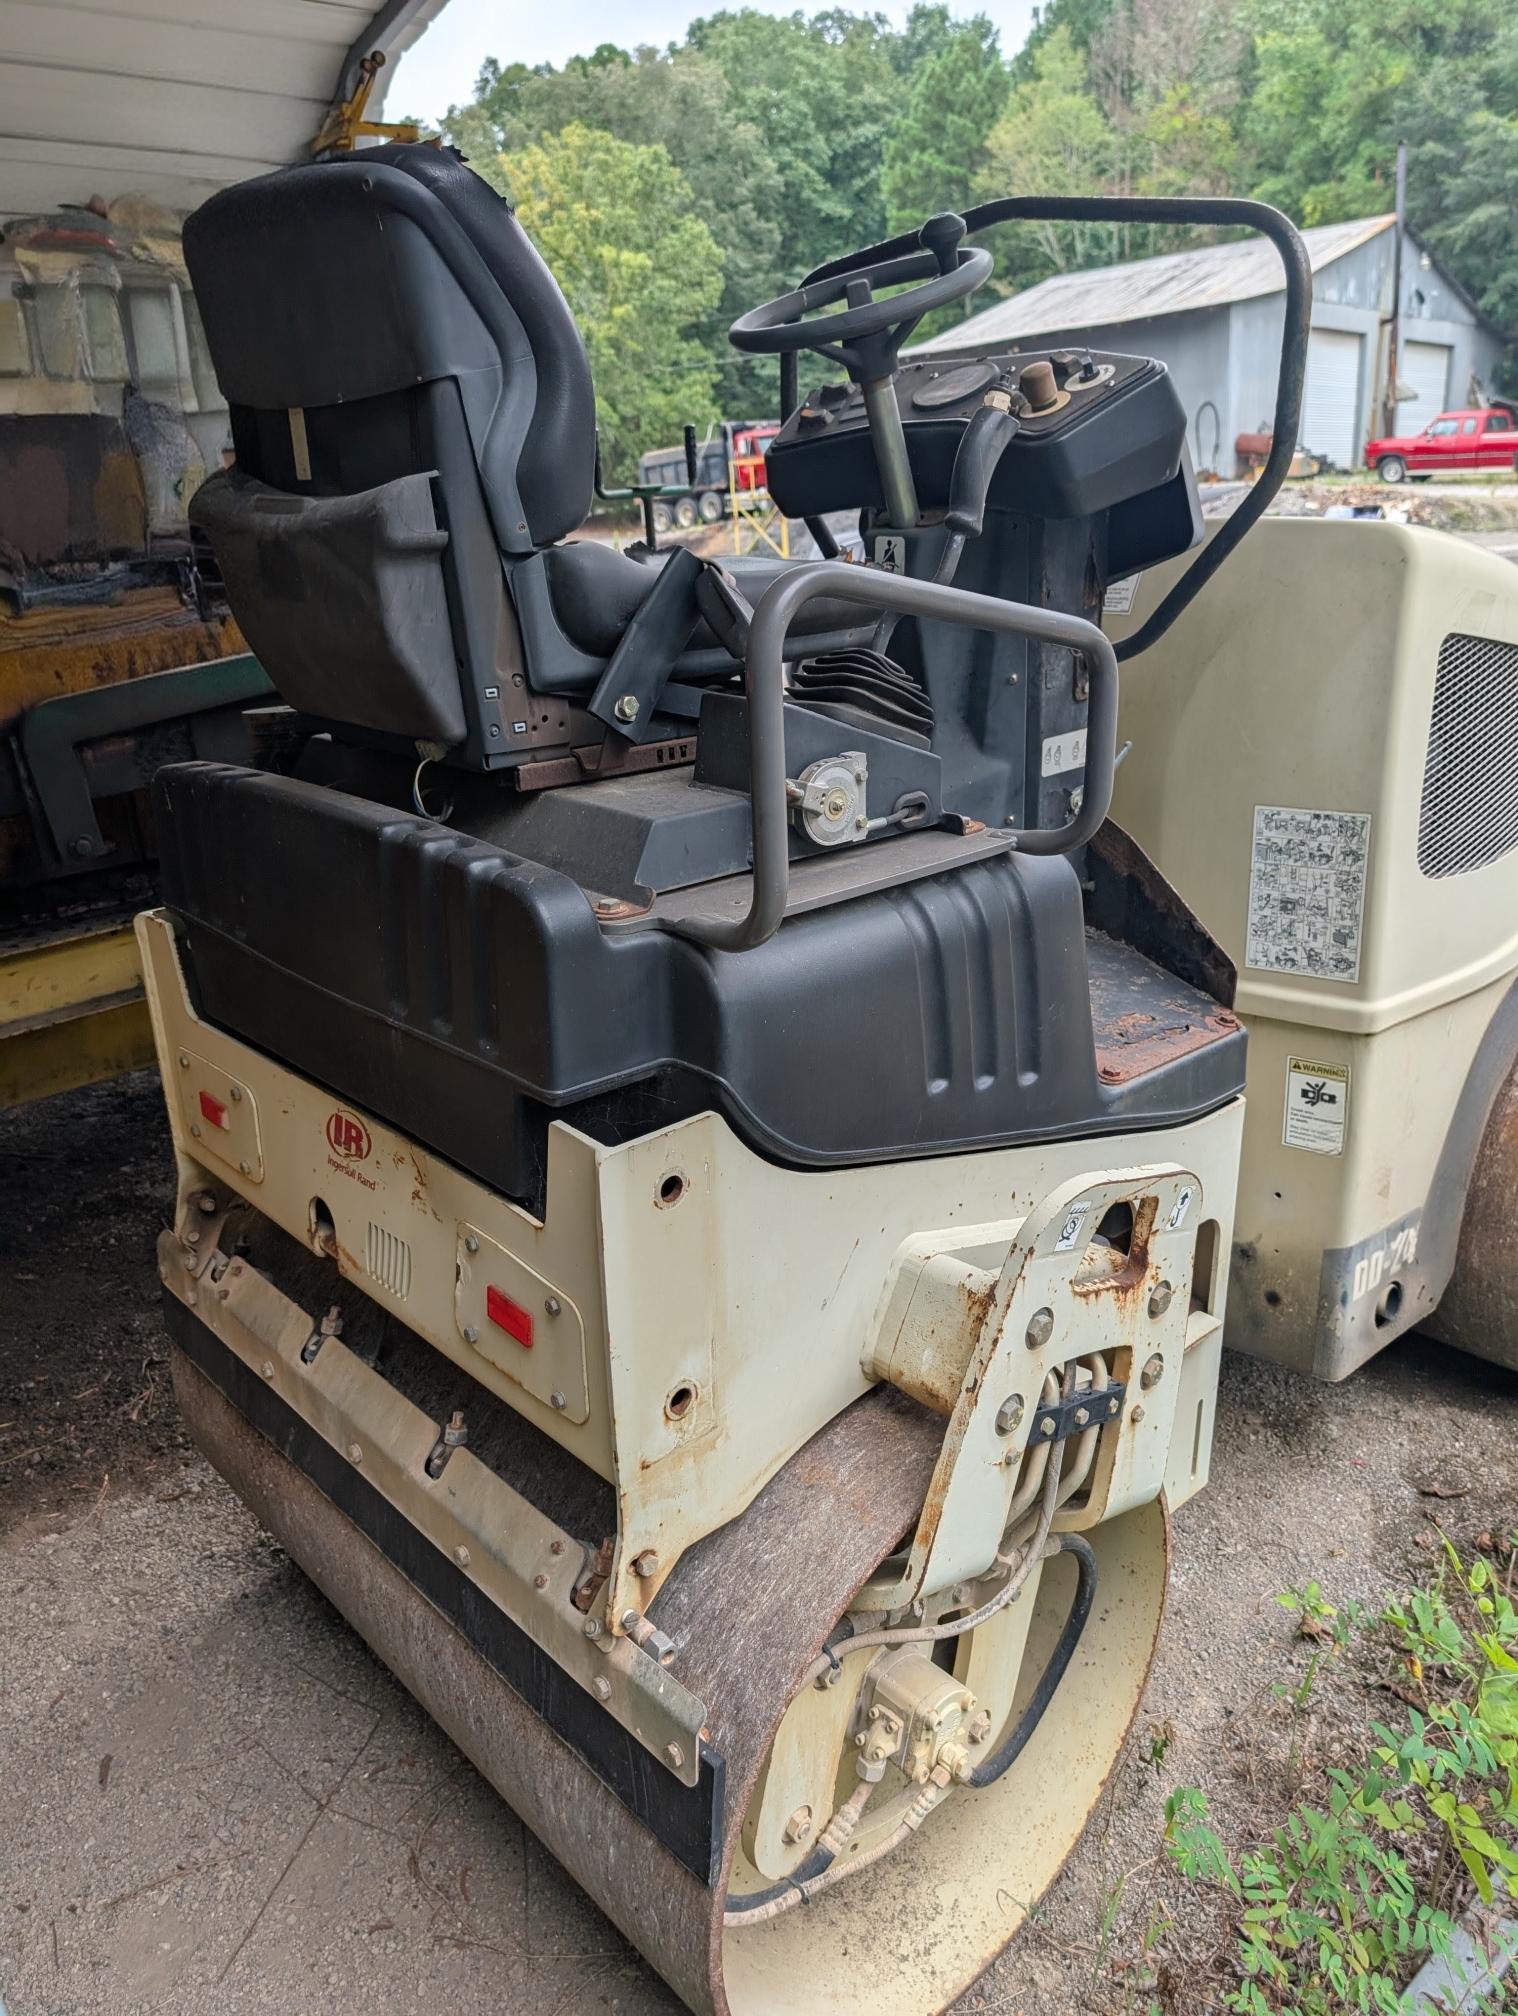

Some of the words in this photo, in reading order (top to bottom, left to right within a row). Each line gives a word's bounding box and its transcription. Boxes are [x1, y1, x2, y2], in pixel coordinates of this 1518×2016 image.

[334, 1112, 364, 1160] IR
[327, 1154, 356, 1179] Ingersoll
[357, 1172, 376, 1191] Rand
